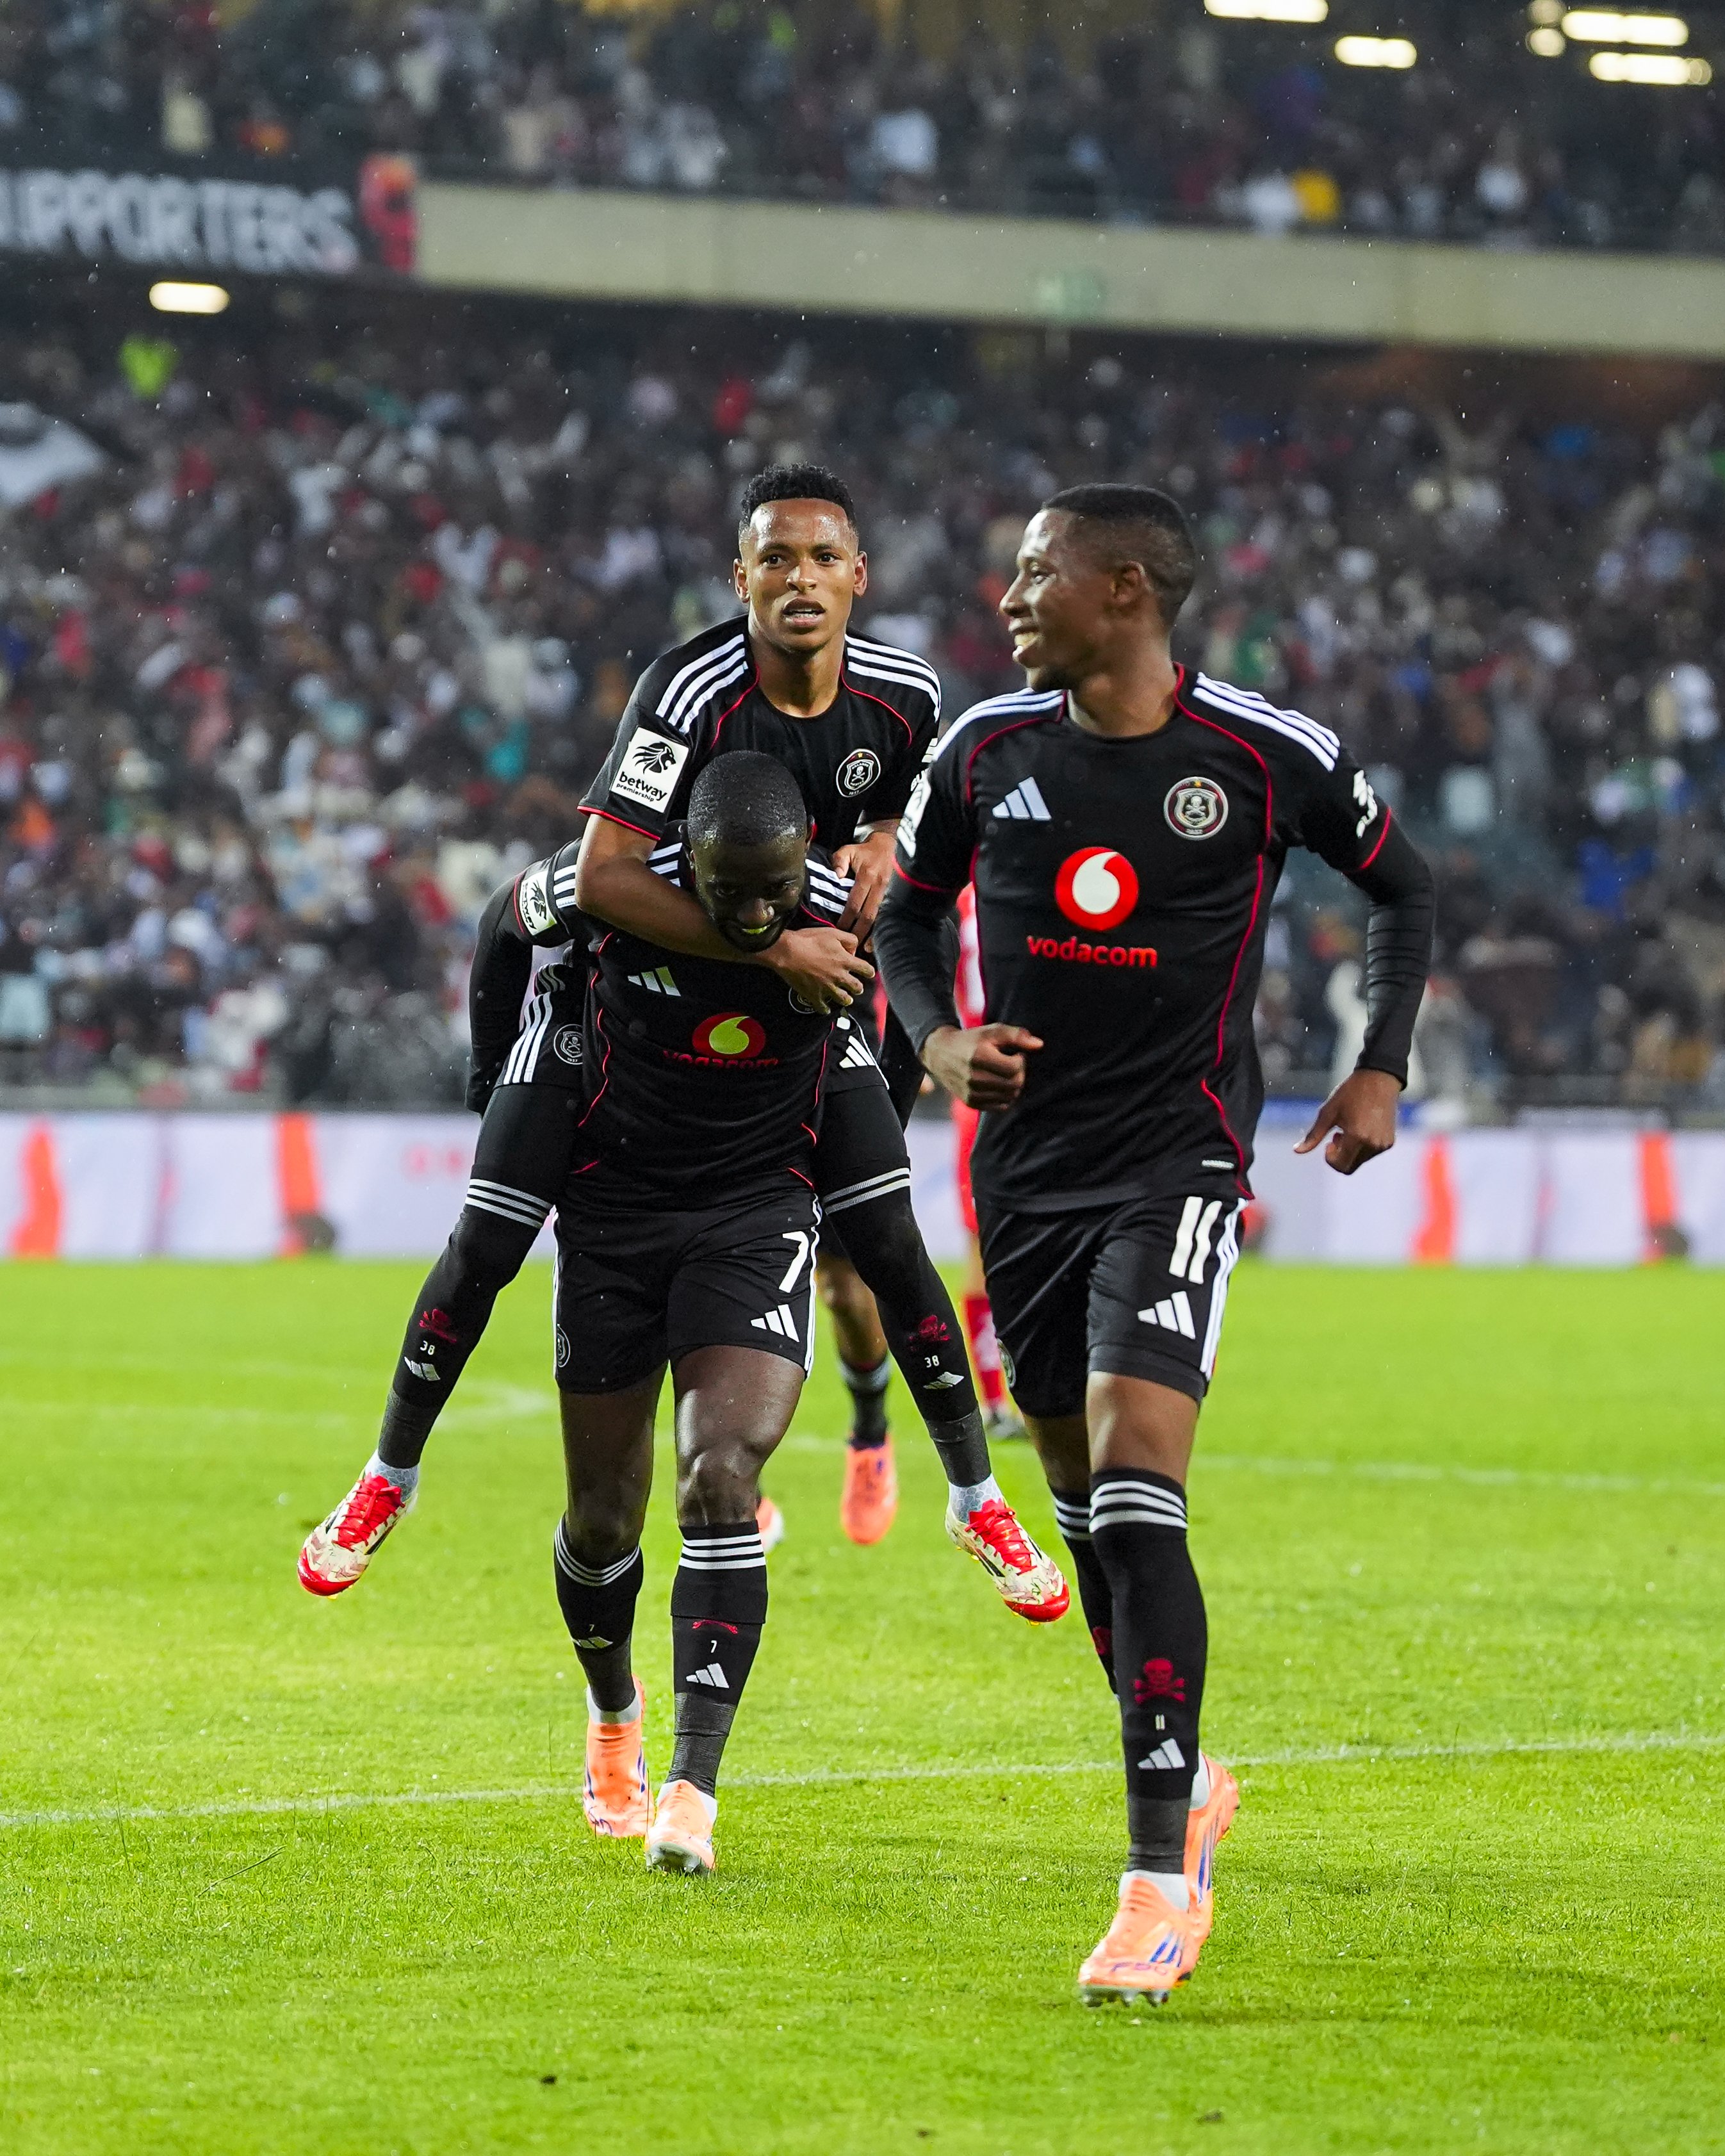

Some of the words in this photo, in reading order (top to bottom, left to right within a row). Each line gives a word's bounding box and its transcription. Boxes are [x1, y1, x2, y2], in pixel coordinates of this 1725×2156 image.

[616, 783, 655, 802] premiership
[619, 771, 667, 801] betway
[1026, 935, 1157, 968] vodacom
[1168, 1196, 1223, 1285] 11
[778, 1230, 809, 1293] 7
[420, 1340, 435, 1355] 38
[924, 1355, 940, 1368] 38
[710, 1640, 717, 1653] 7
[1155, 1714, 1165, 1731] 11
